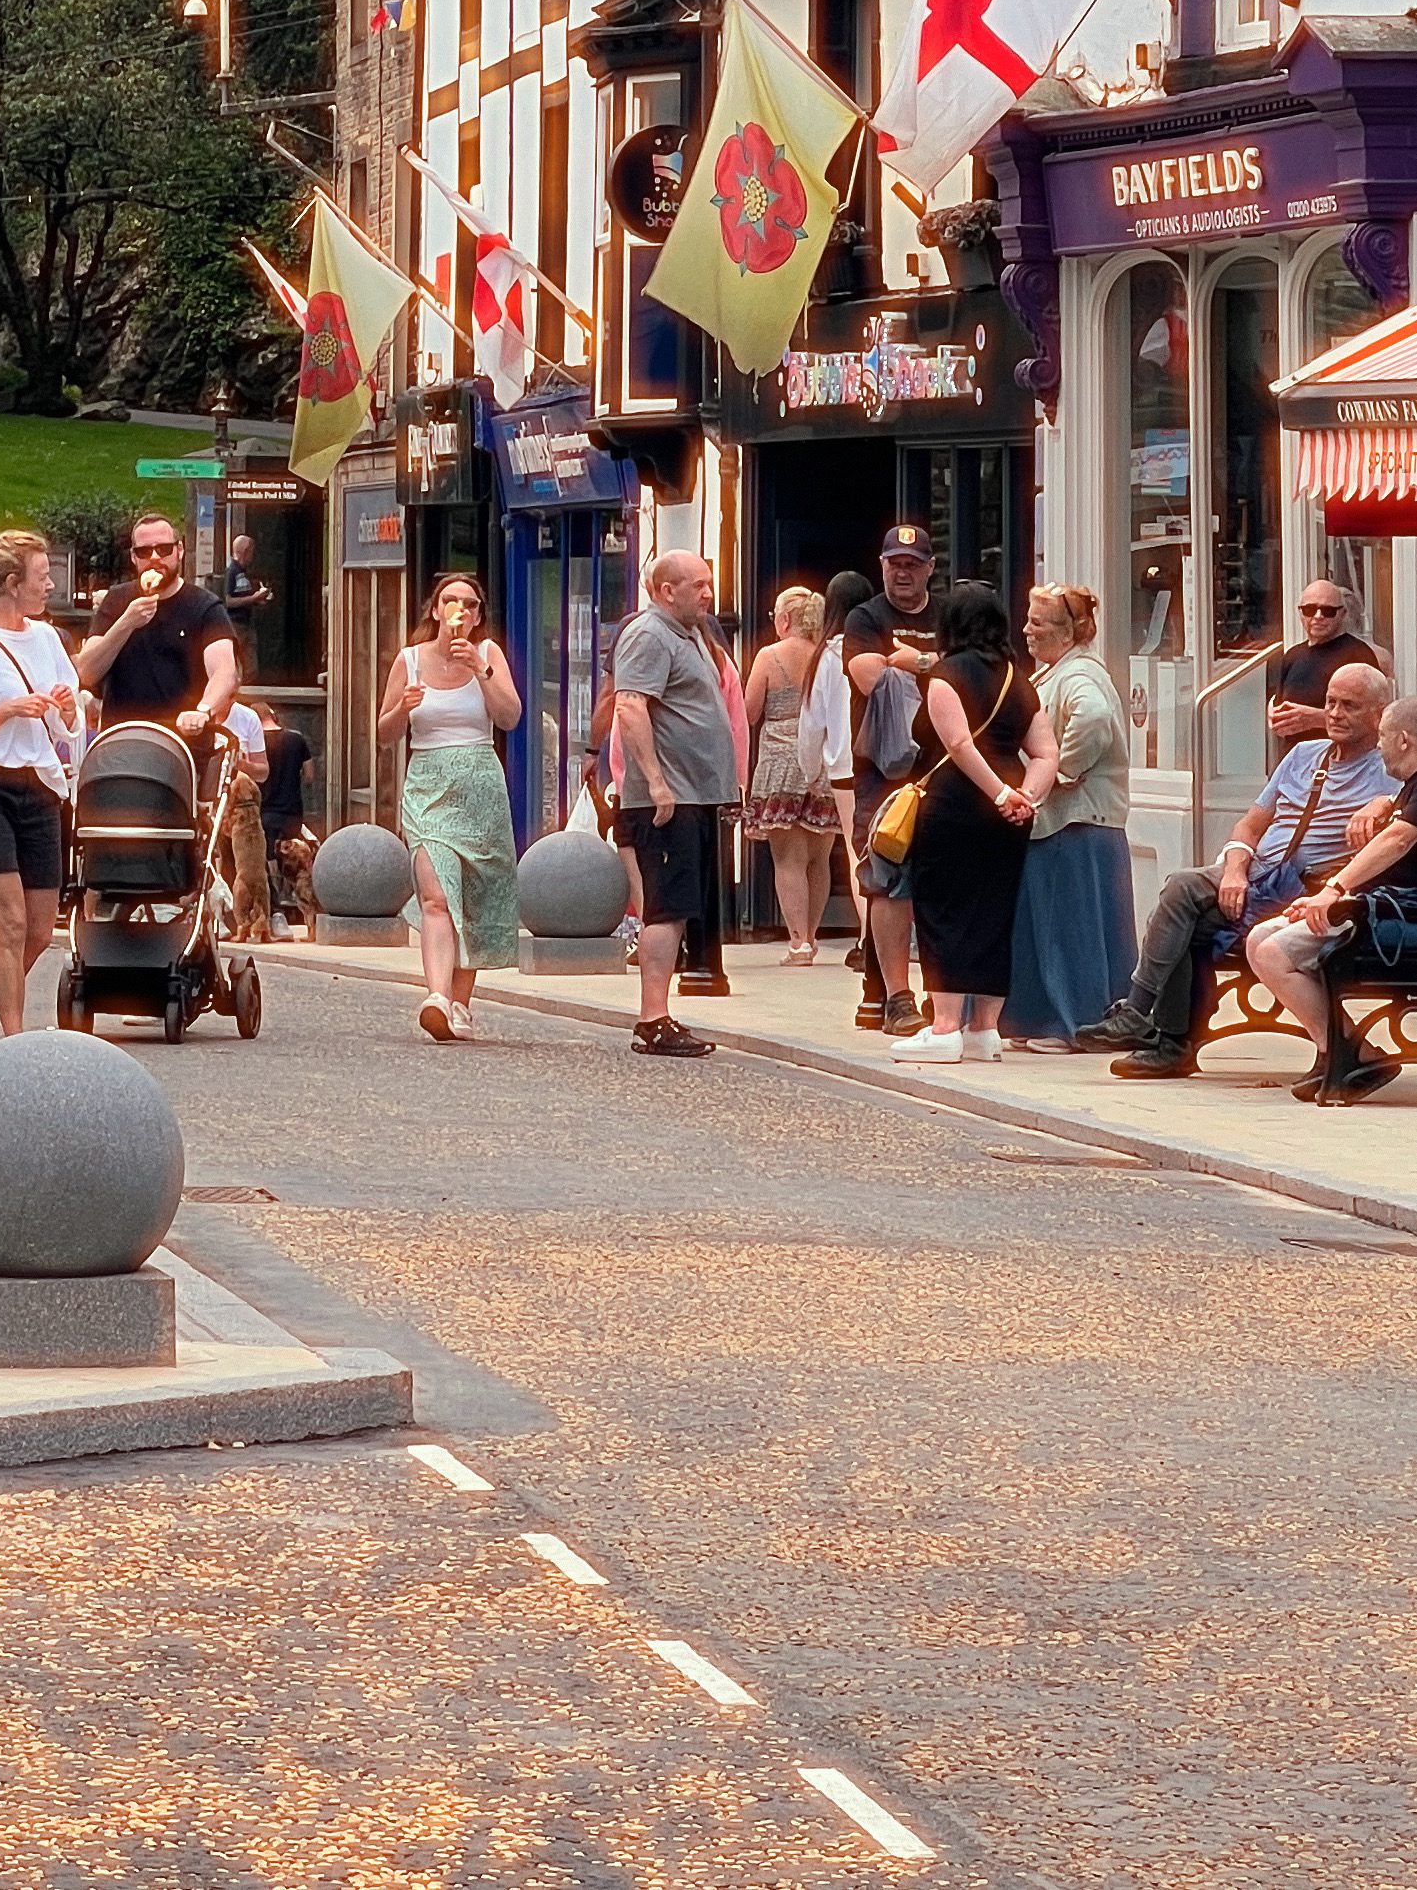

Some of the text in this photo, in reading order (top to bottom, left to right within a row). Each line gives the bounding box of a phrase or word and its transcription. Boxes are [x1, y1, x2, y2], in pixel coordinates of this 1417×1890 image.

[1111, 146, 1264, 207] BAYFIELDS
[1134, 204, 1261, 239] OPTICIANS & AUDIOLOGISTS
